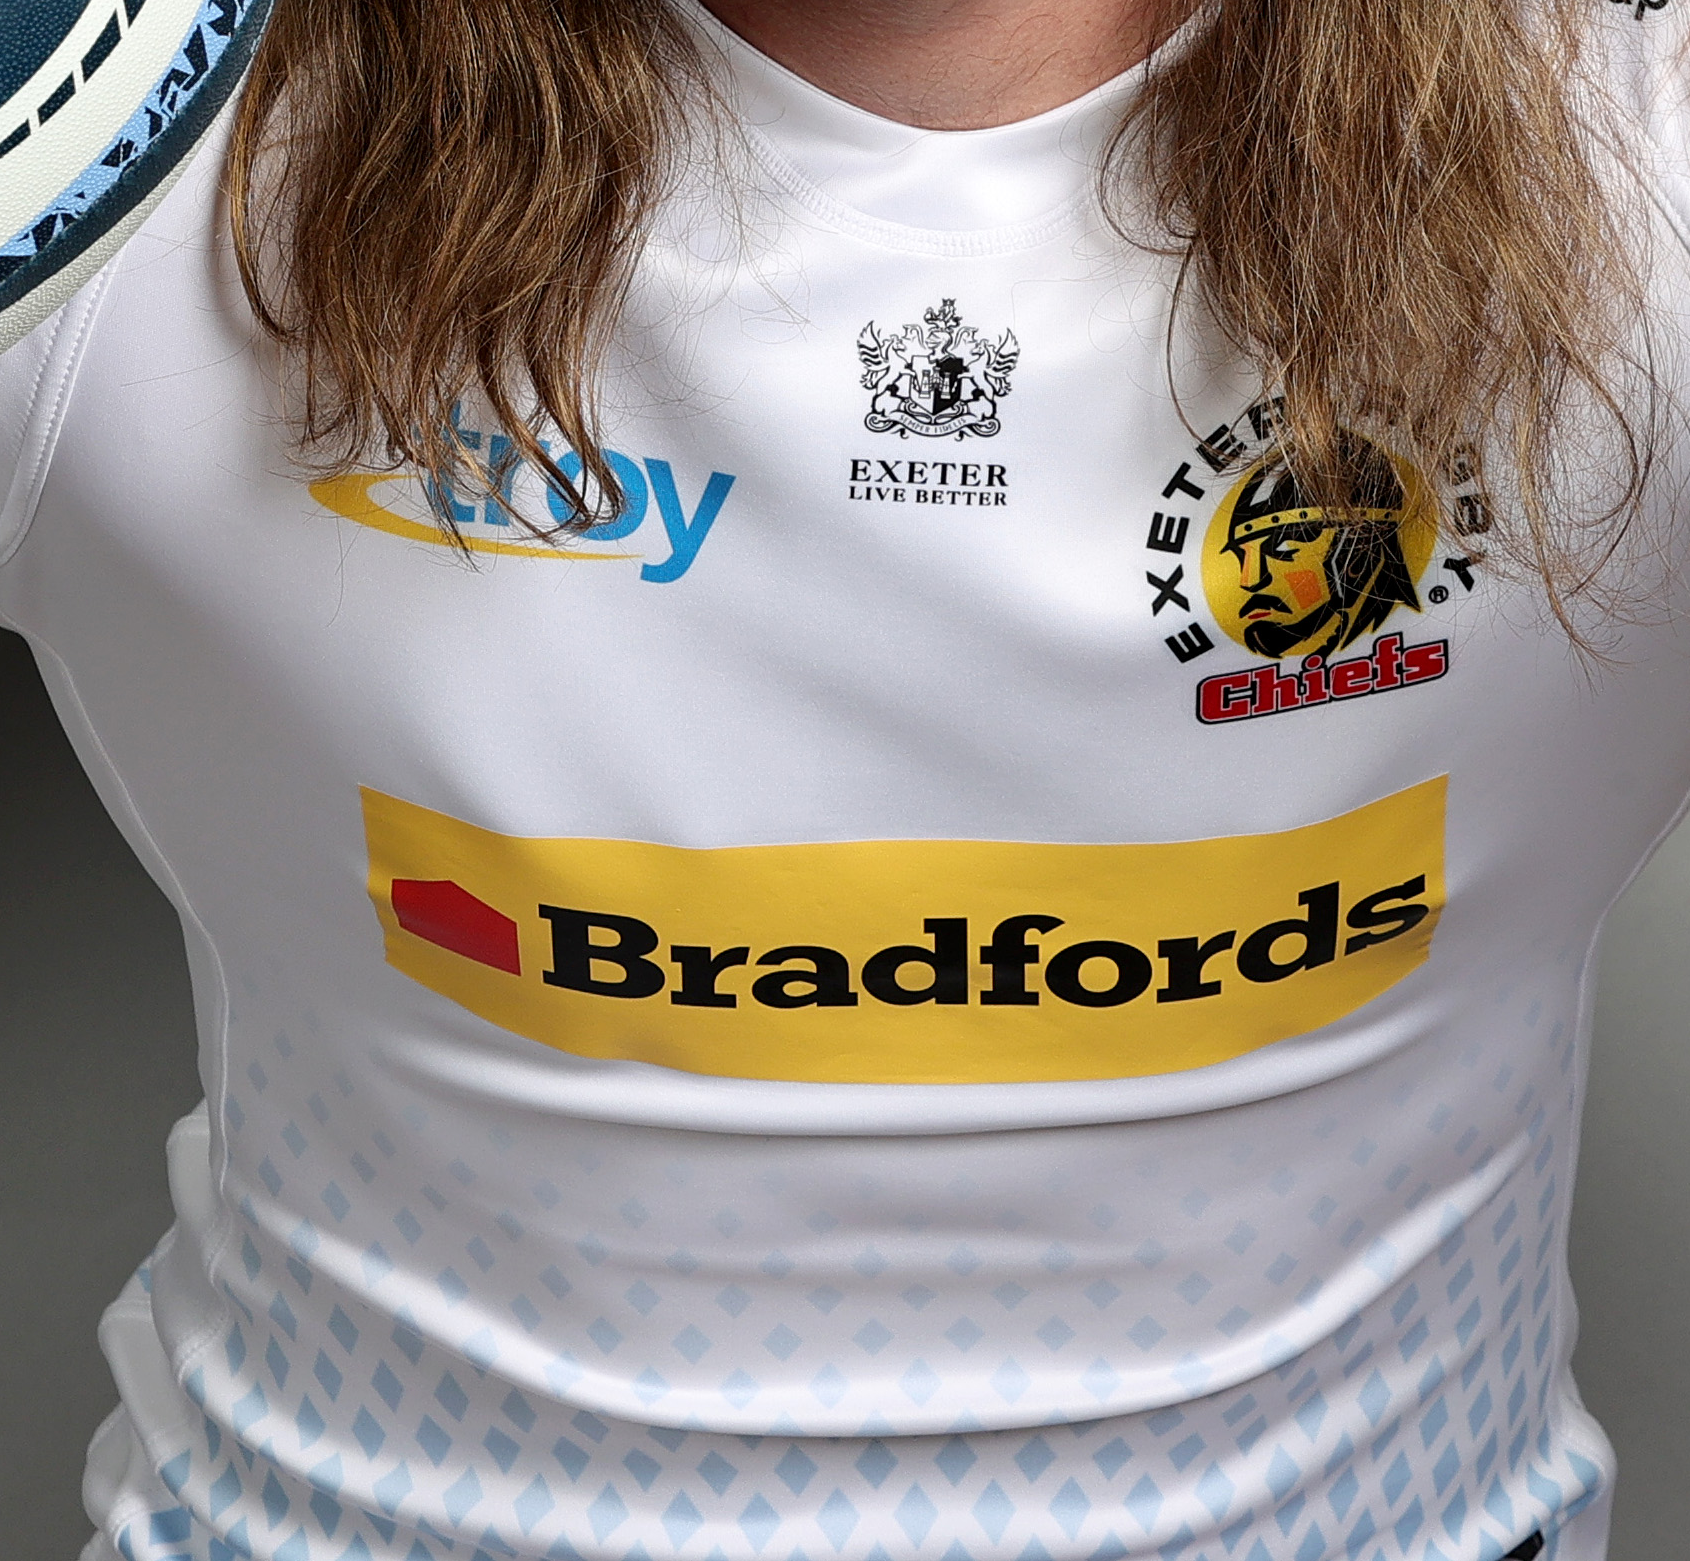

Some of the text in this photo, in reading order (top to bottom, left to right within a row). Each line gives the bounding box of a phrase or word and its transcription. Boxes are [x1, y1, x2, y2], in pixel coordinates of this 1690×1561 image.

[848, 486, 1007, 506] LIVE BETTER
[849, 458, 1009, 487] EXETER
[1196, 632, 1449, 725] Chiefs
[538, 873, 1429, 1010] Bradfords
